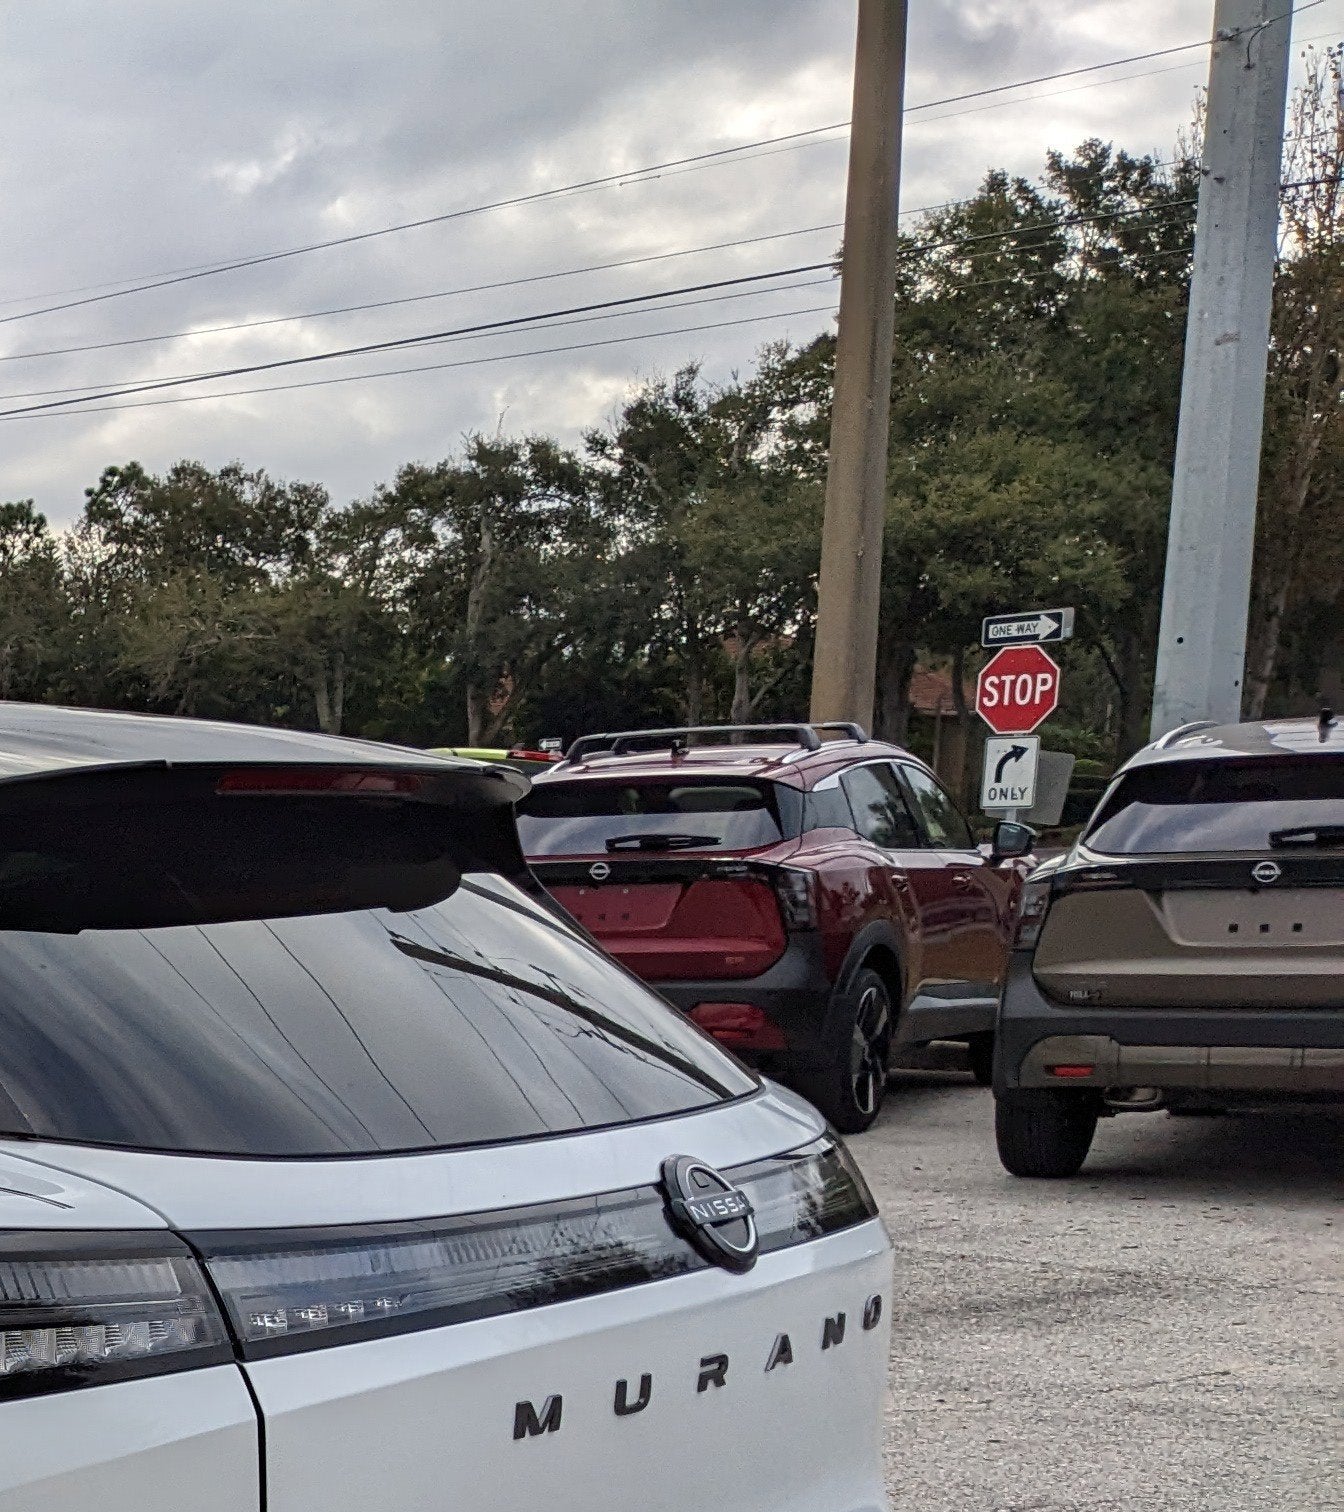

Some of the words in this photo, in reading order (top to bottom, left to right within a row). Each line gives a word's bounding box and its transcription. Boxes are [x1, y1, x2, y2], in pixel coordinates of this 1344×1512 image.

[991, 625, 1013, 637] ONE
[1016, 622, 1039, 634] WAY
[981, 673, 1053, 708] STOP
[988, 786, 1028, 801] ONLY
[689, 1194, 746, 1220] NISSA
[512, 1294, 883, 1441] MURANO
